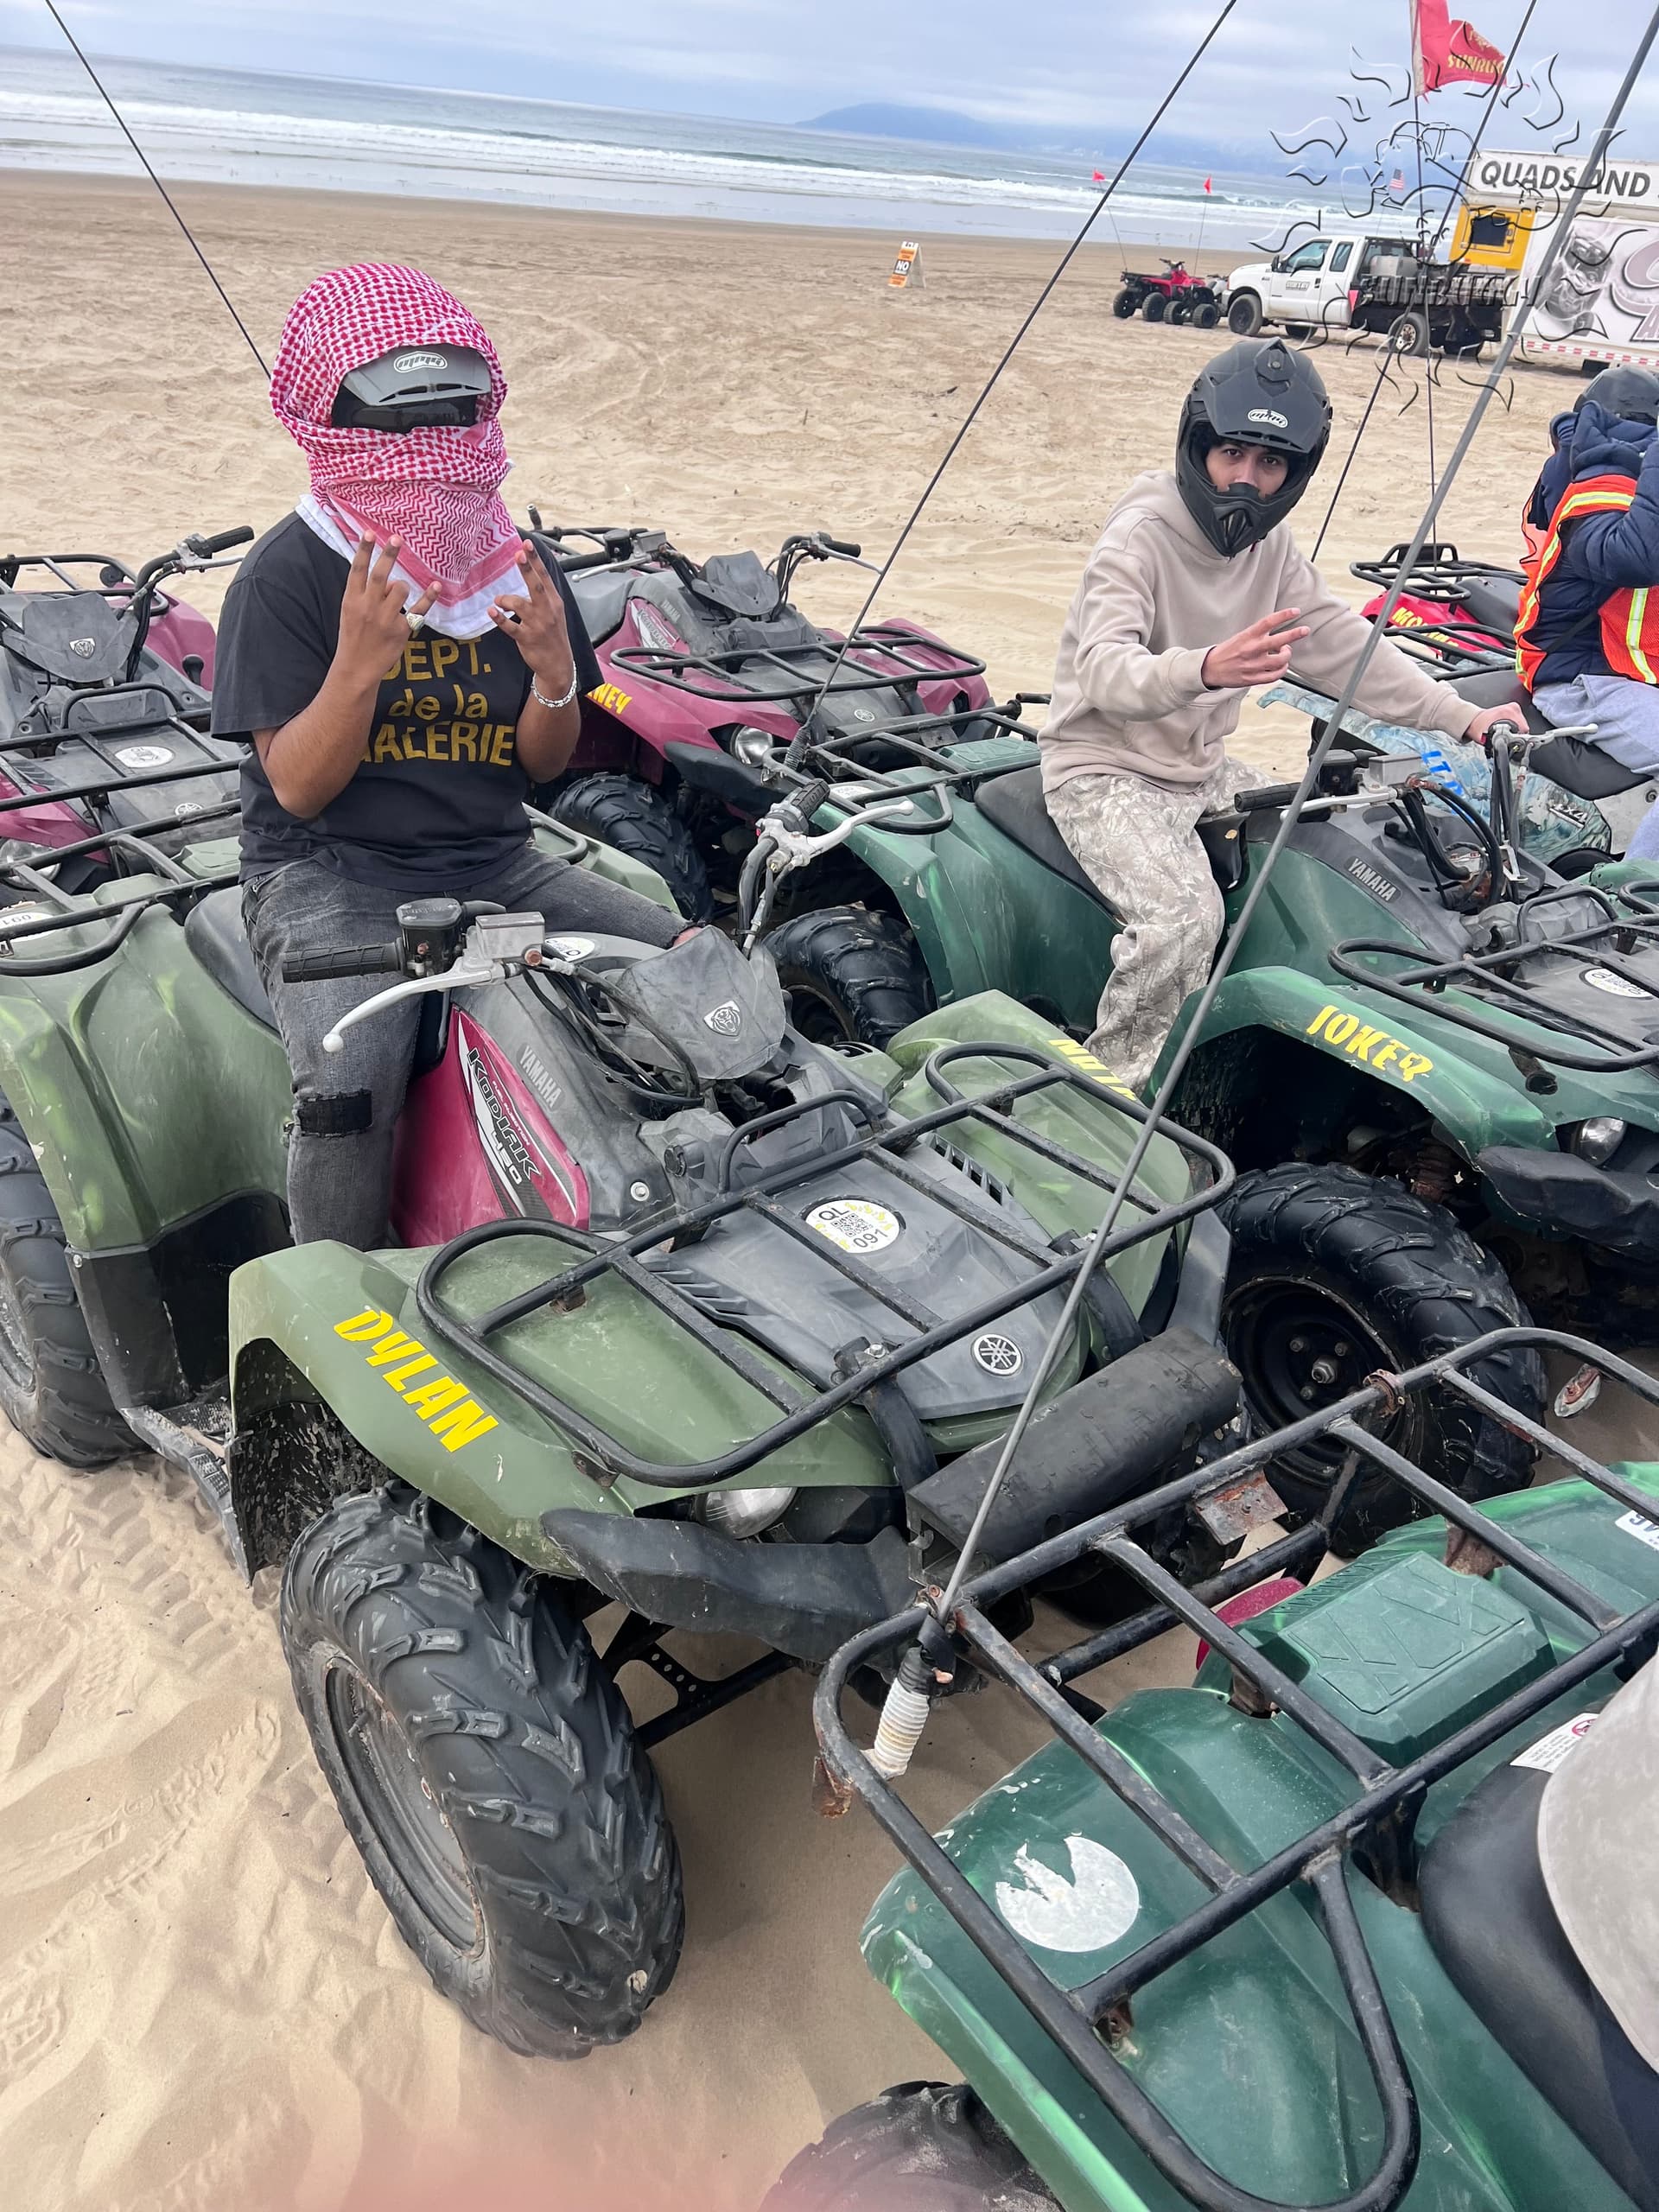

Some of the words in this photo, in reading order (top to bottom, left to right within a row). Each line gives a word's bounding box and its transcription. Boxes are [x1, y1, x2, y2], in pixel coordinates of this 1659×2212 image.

[1481, 161, 1576, 191] QUADS
[896, 261, 910, 270] NO
[388, 688, 441, 720] de
[454, 684, 489, 719] la
[359, 721, 516, 766] ALERIE
[1348, 858, 1396, 901] YAMAHA
[519, 1046, 562, 1109] YAMAHA
[467, 1047, 542, 1180] KODIAK
[491, 1131, 522, 1185] 450
[818, 1207, 850, 1221] QL
[853, 1229, 888, 1248] 091
[334, 1310, 499, 1452] DYLAN
